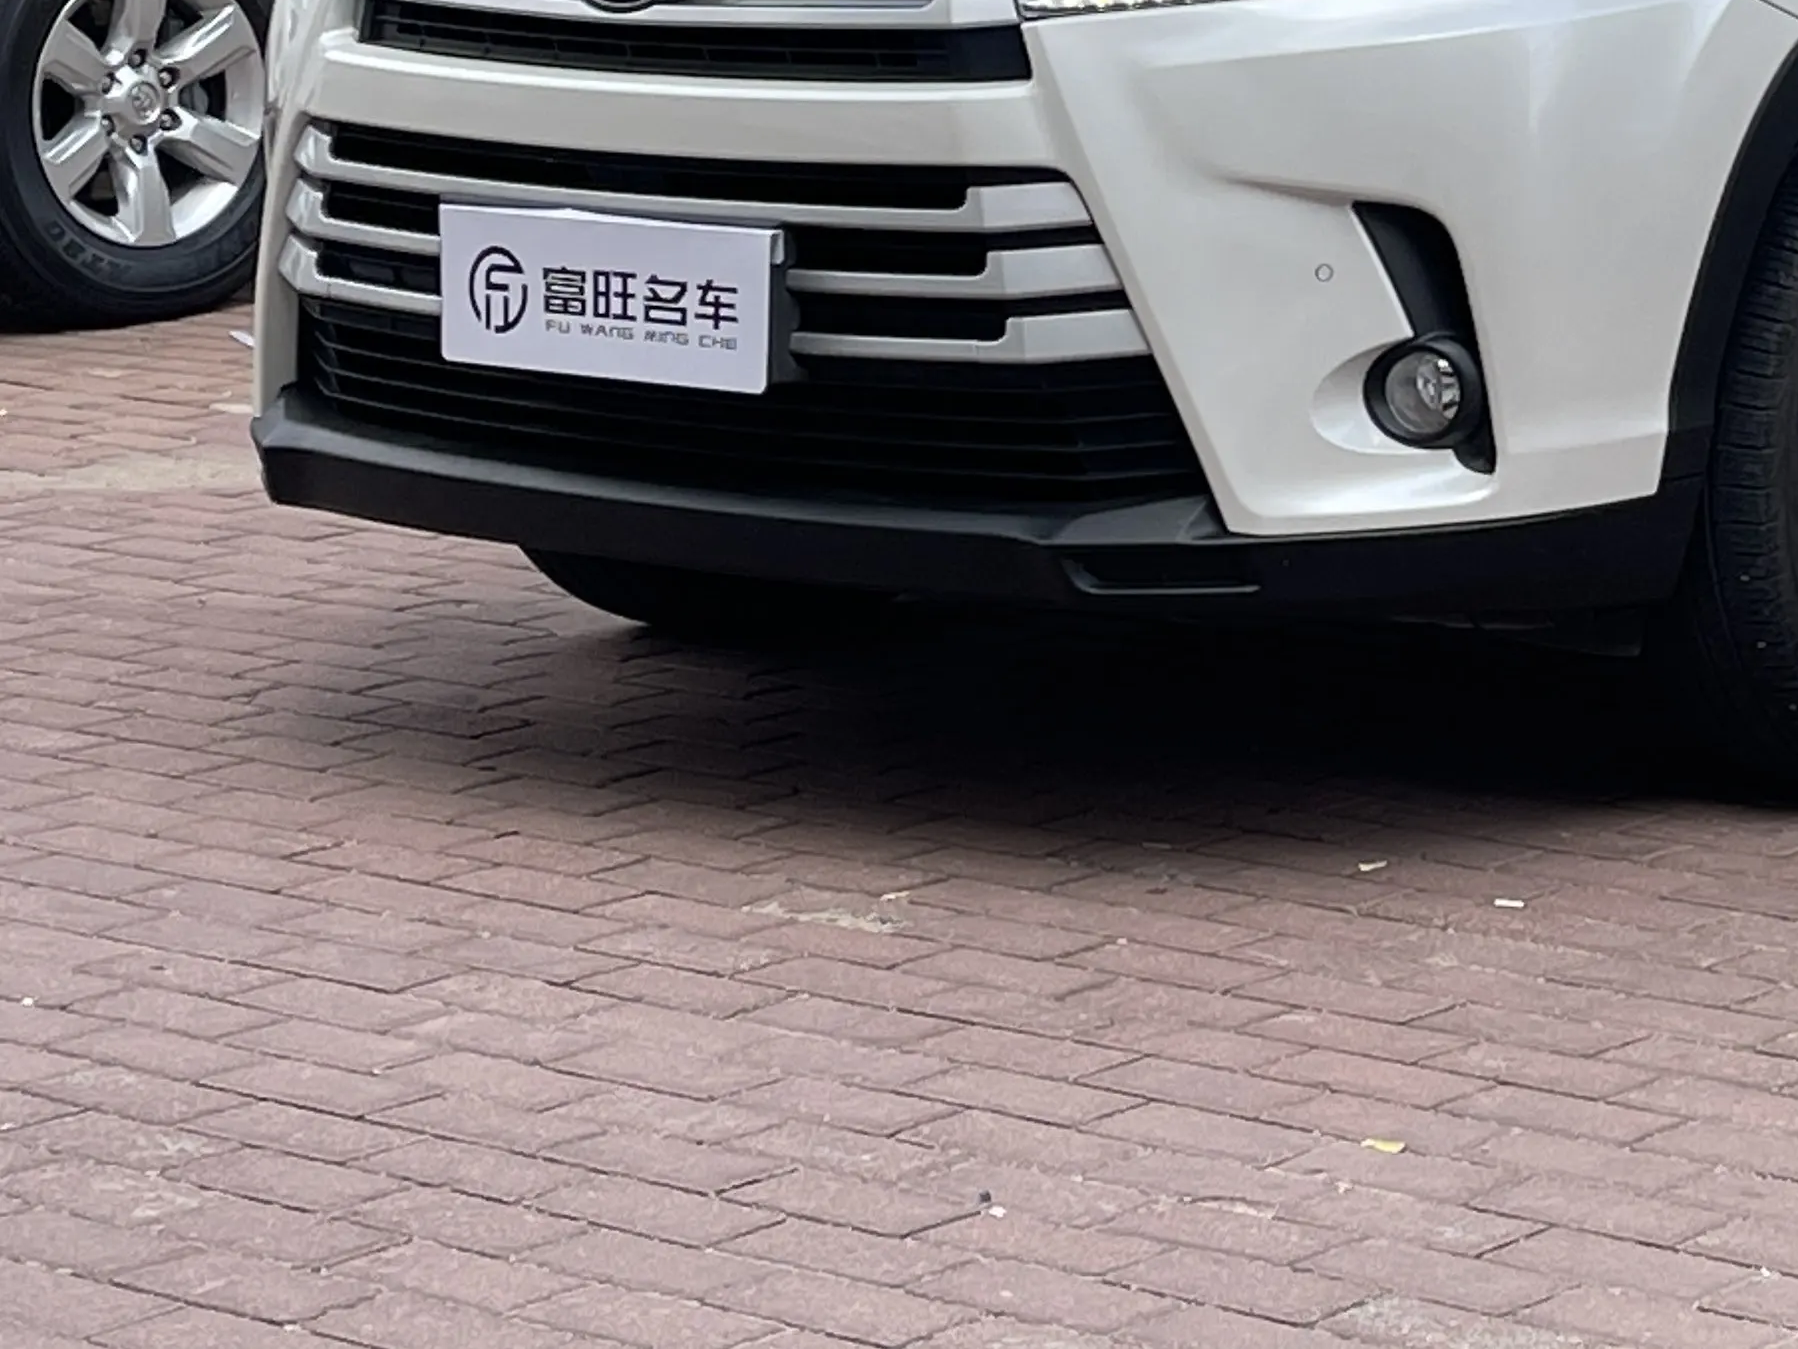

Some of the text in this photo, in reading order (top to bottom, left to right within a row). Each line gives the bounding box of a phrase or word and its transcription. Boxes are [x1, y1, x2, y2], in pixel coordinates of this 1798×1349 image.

[542, 266, 739, 330] 富旺名车
[545, 319, 571, 334] FU
[580, 323, 634, 341] WANG
[643, 330, 690, 347] MING
